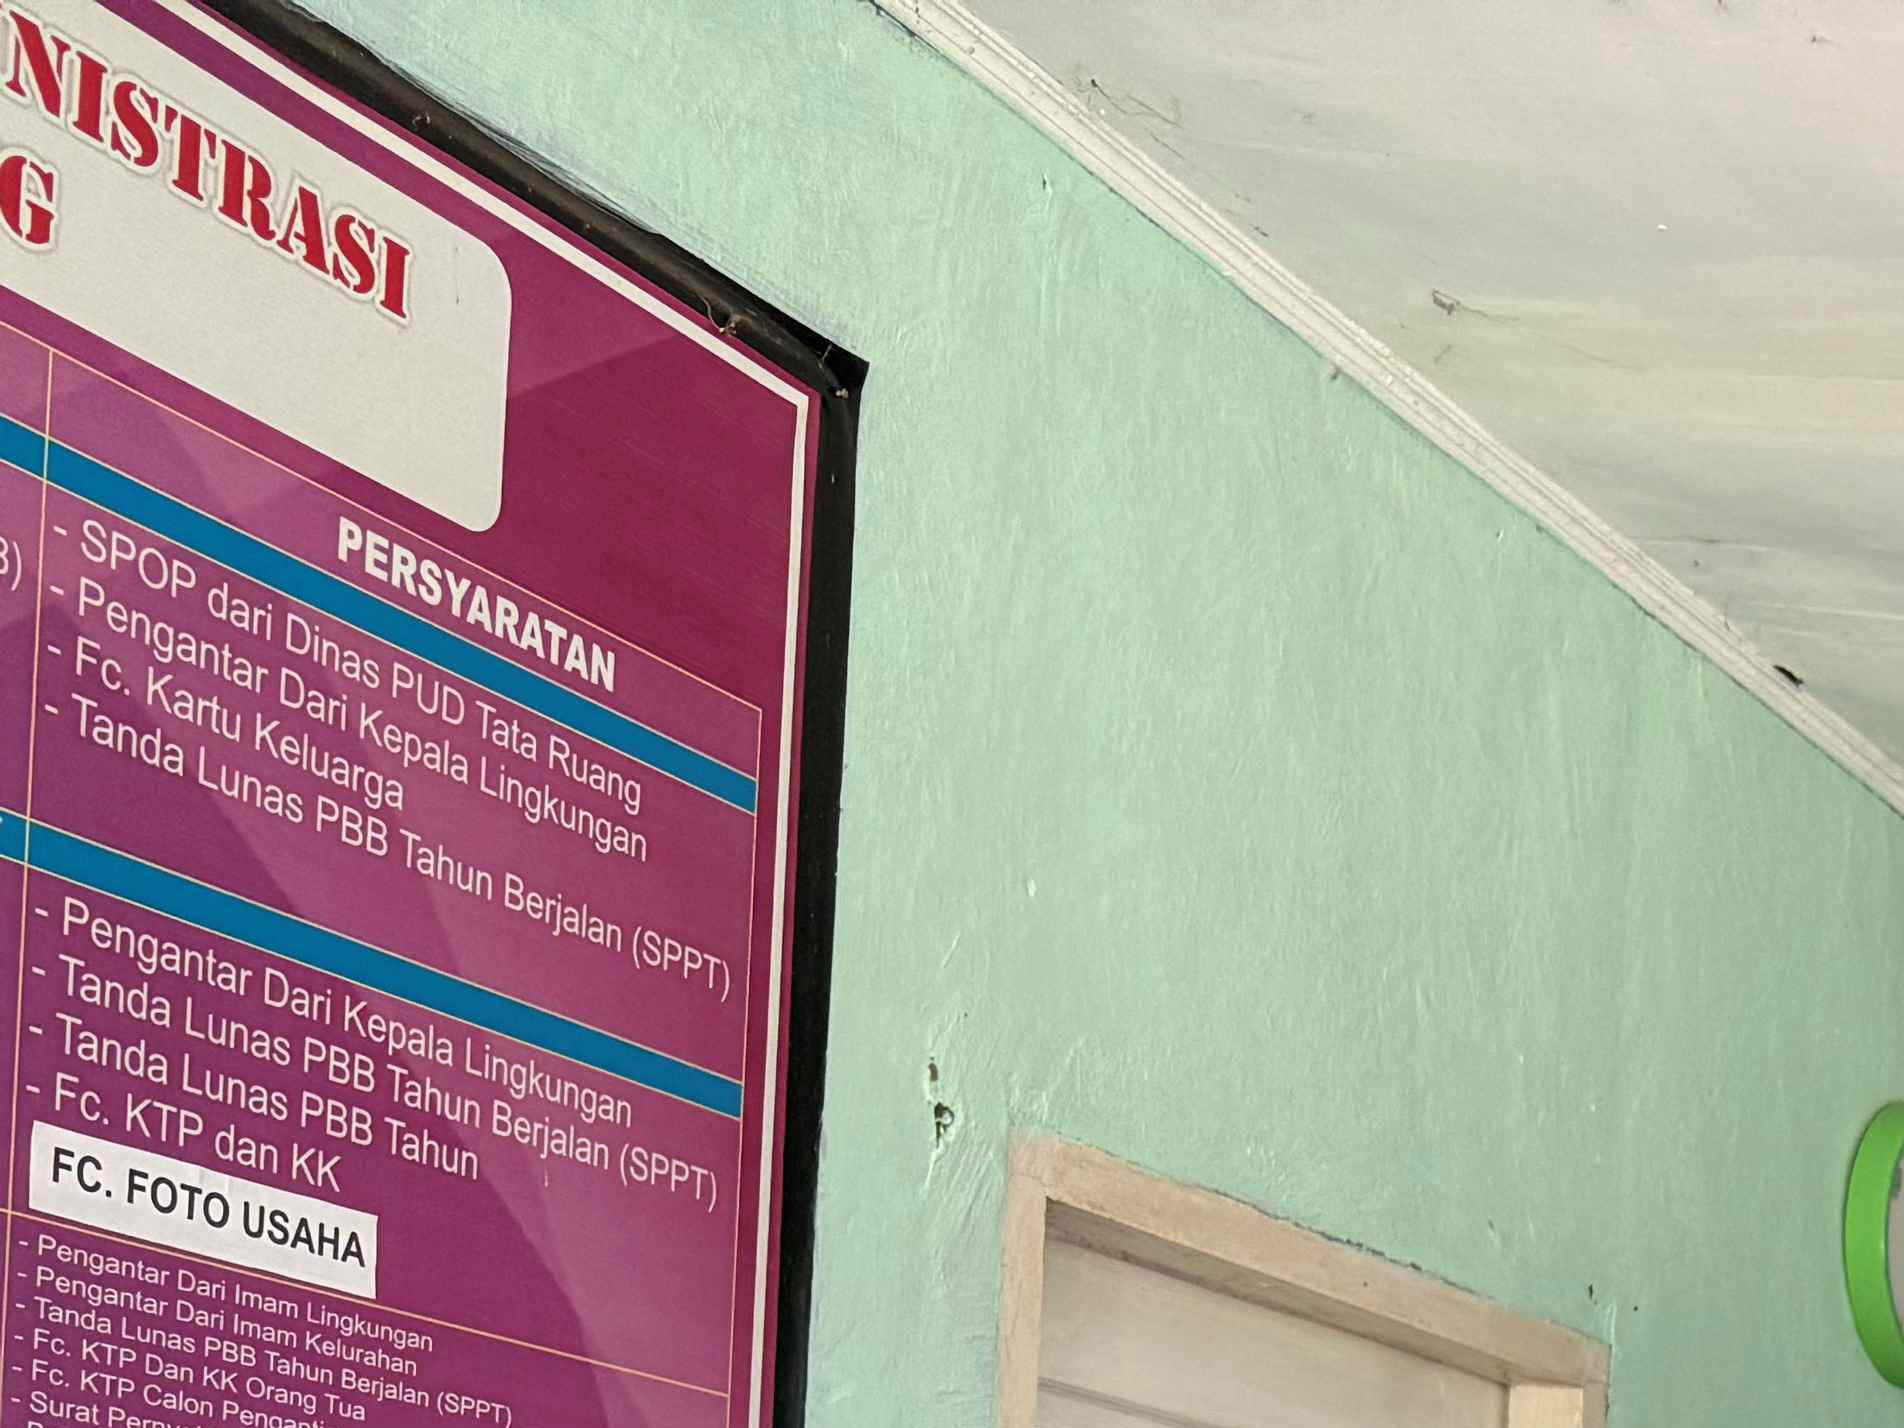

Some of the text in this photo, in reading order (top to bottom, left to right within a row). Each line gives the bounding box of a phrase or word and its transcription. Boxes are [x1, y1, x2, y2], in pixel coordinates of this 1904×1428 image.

[79, 518, 196, 598] SPOP
[206, 581, 273, 641] dari
[285, 611, 380, 689] Dinas
[391, 661, 465, 725] PUD
[474, 699, 537, 762] Tata
[547, 734, 641, 816] Ruang
[336, 515, 615, 693] PERSYARATAN
[74, 634, 404, 811] Fc. Kartu Keluarga
[77, 575, 647, 862] Pengantar Dari Kepala Lingkungan
[70, 691, 730, 1003] Tanda Lunas PBB Tahun Berjalan (SPPT)
[57, 952, 717, 1213] Tanda Lunas PBB Tahun Berjalan (SPPT)
[62, 895, 632, 1128] Pengantar Dari Kepala Lingkungan
[54, 1011, 478, 1180] Tanda Lunas PBB Tahun
[54, 1070, 341, 1193] Fc. KTP dan KK
[51, 1145, 365, 1268] FC. FOTO USAHA
[32, 1294, 112, 1335] Tanda
[120, 1315, 196, 1353] Lunas
[203, 1335, 256, 1367] PBB
[263, 1348, 333, 1385] Tahun
[340, 1367, 430, 1408] Berjalan
[35, 1264, 417, 1377] Pengantar Dari Imam Kelurahan
[37, 1233, 433, 1352] Pengantar Dari Imam Lingkungan
[28, 1389, 100, 1426] Surat
[30, 1357, 70, 1387] Fc.
[79, 1368, 135, 1399] KTP
[142, 1383, 213, 1418] Calon
[32, 1326, 365, 1421] Fc. KTP Dan KK Orang Tua
